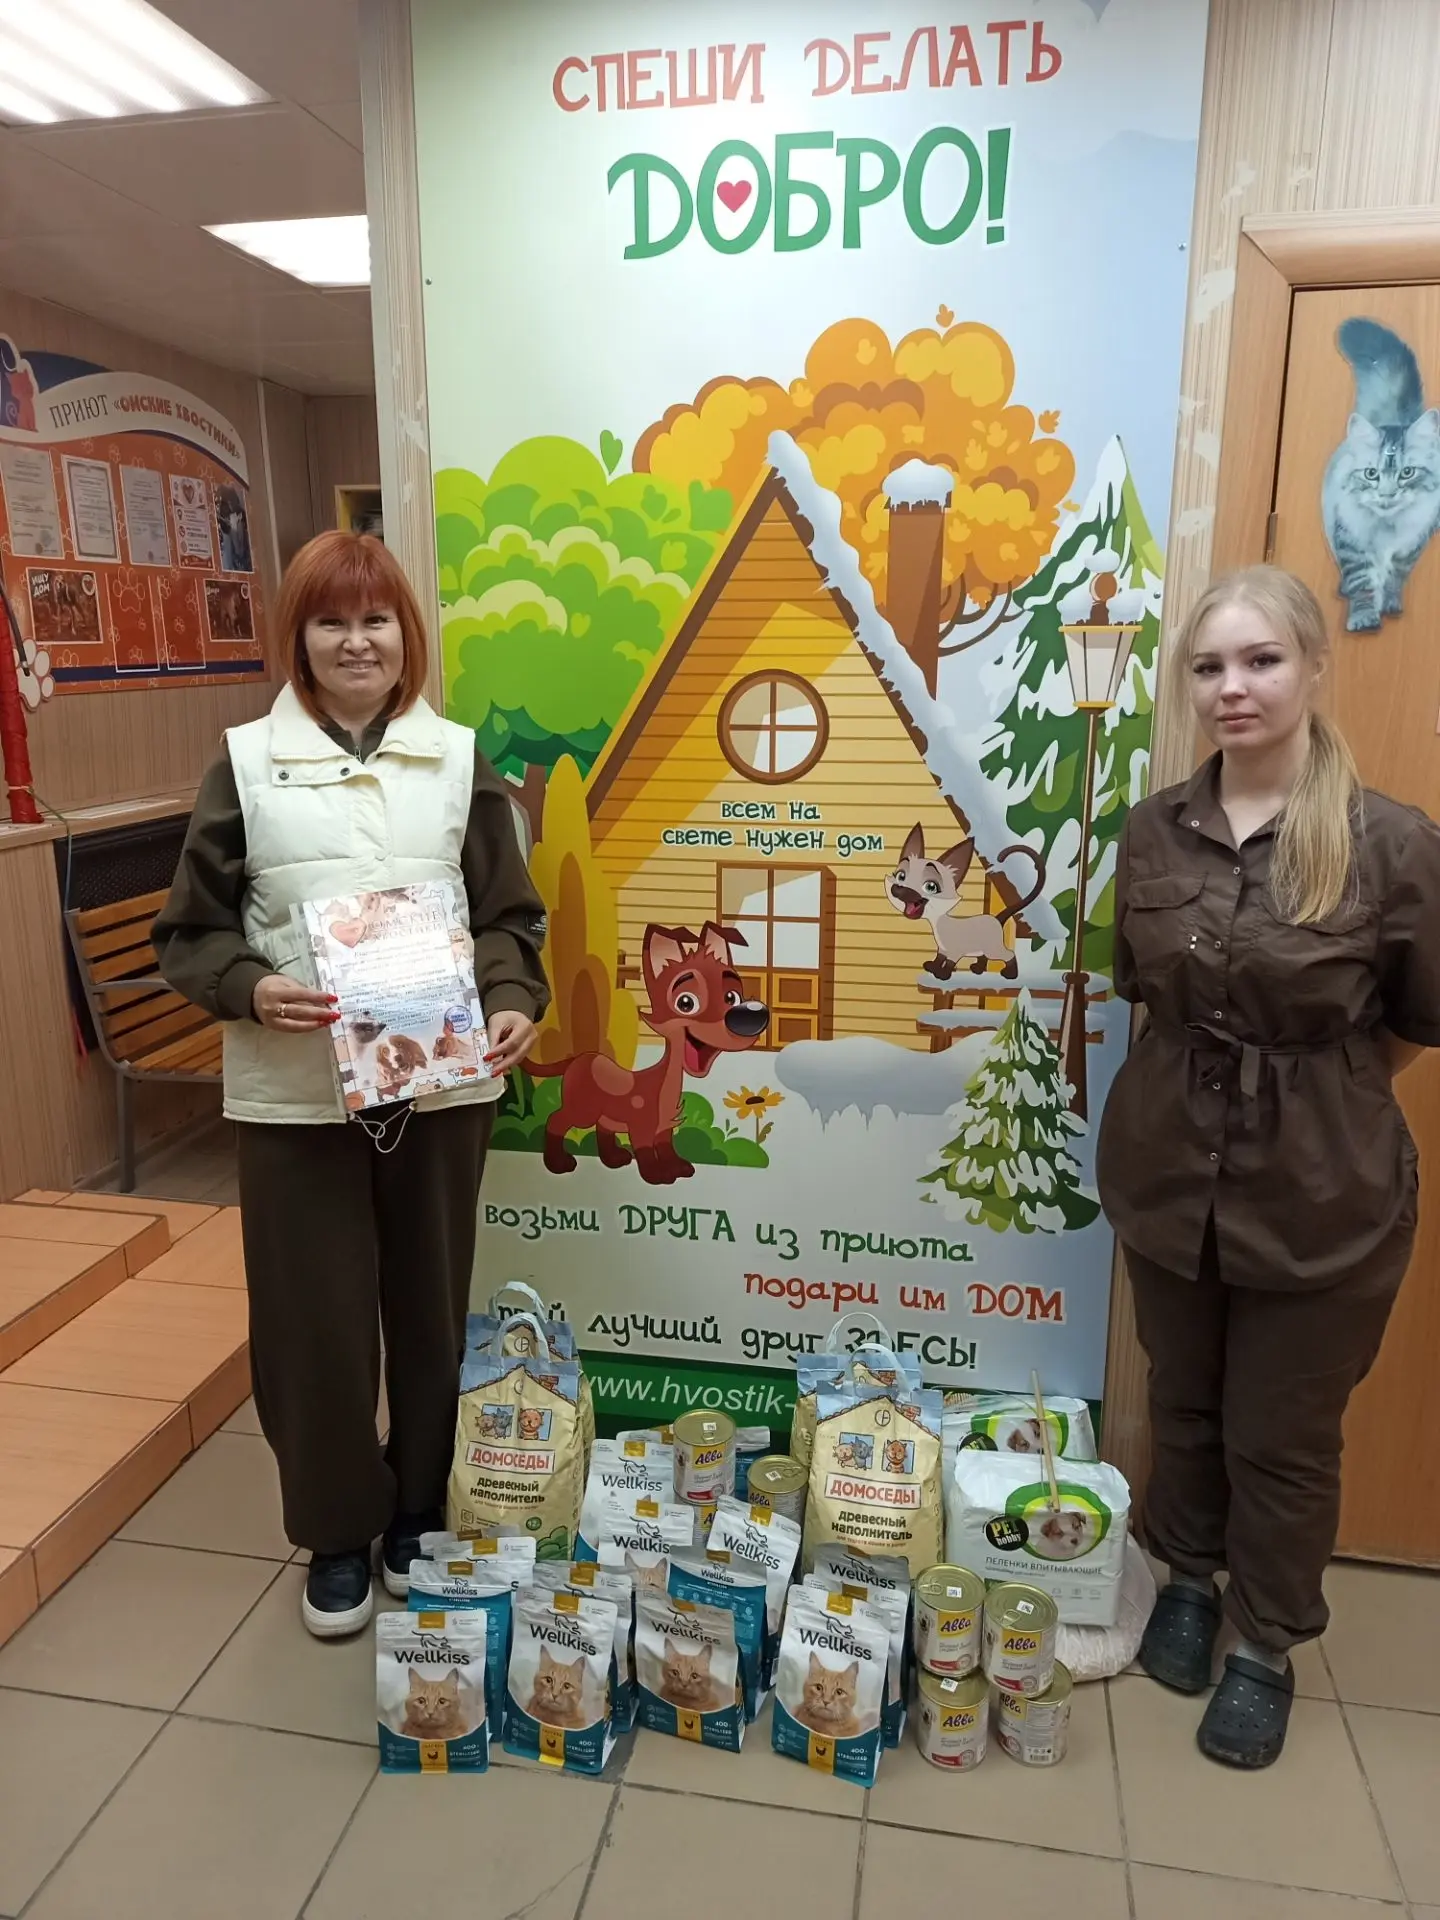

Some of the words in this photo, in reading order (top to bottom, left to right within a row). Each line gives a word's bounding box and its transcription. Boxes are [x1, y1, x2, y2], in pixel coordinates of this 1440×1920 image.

[552, 43, 766, 112] СПЕШИ
[803, 20, 1063, 97] ДЕЛАТЬ
[607, 126, 1011, 260] ДОБРО!
[50, 394, 108, 429] ПРИЮТ
[662, 829, 733, 846] свете
[746, 829, 824, 855] нужен
[837, 834, 883, 857] дом
[618, 1204, 736, 1243] ДРУГА
[755, 1222, 801, 1260] из
[820, 1228, 974, 1262] приюта
[743, 1273, 879, 1311] подари
[900, 1284, 945, 1311] им
[967, 1282, 1063, 1321] ДОМ
[587, 1314, 722, 1346] лучший
[741, 1327, 824, 1363] друг
[471, 1447, 550, 1470] ДОМОСЕДЫ
[476, 1476, 540, 1492] древесный
[602, 1474, 663, 1491] Wellkiss
[830, 1479, 916, 1505] ДОМОСЕДЫ
[469, 1486, 545, 1504] наполнитель
[838, 1510, 906, 1528] древесный
[990, 1519, 1019, 1538] PET
[831, 1522, 912, 1541] наполнитель
[995, 1533, 1022, 1546] hobby
[612, 1535, 670, 1554] Wellkis
[724, 1532, 780, 1571] Wellkiss
[701, 1569, 735, 1584] Wellkiss
[829, 1562, 896, 1590] Wellkiss
[985, 1556, 1028, 1569] ПЕЛЕНКИ
[1030, 1563, 1103, 1576] ВПИТЫВАЮЩИЕ
[441, 1586, 478, 1596] Wellkiss
[530, 1623, 597, 1656] Wellkiss
[651, 1620, 722, 1646] Wellkiss
[799, 1627, 872, 1661] Wellkiss
[394, 1650, 471, 1665] Wellkiss
